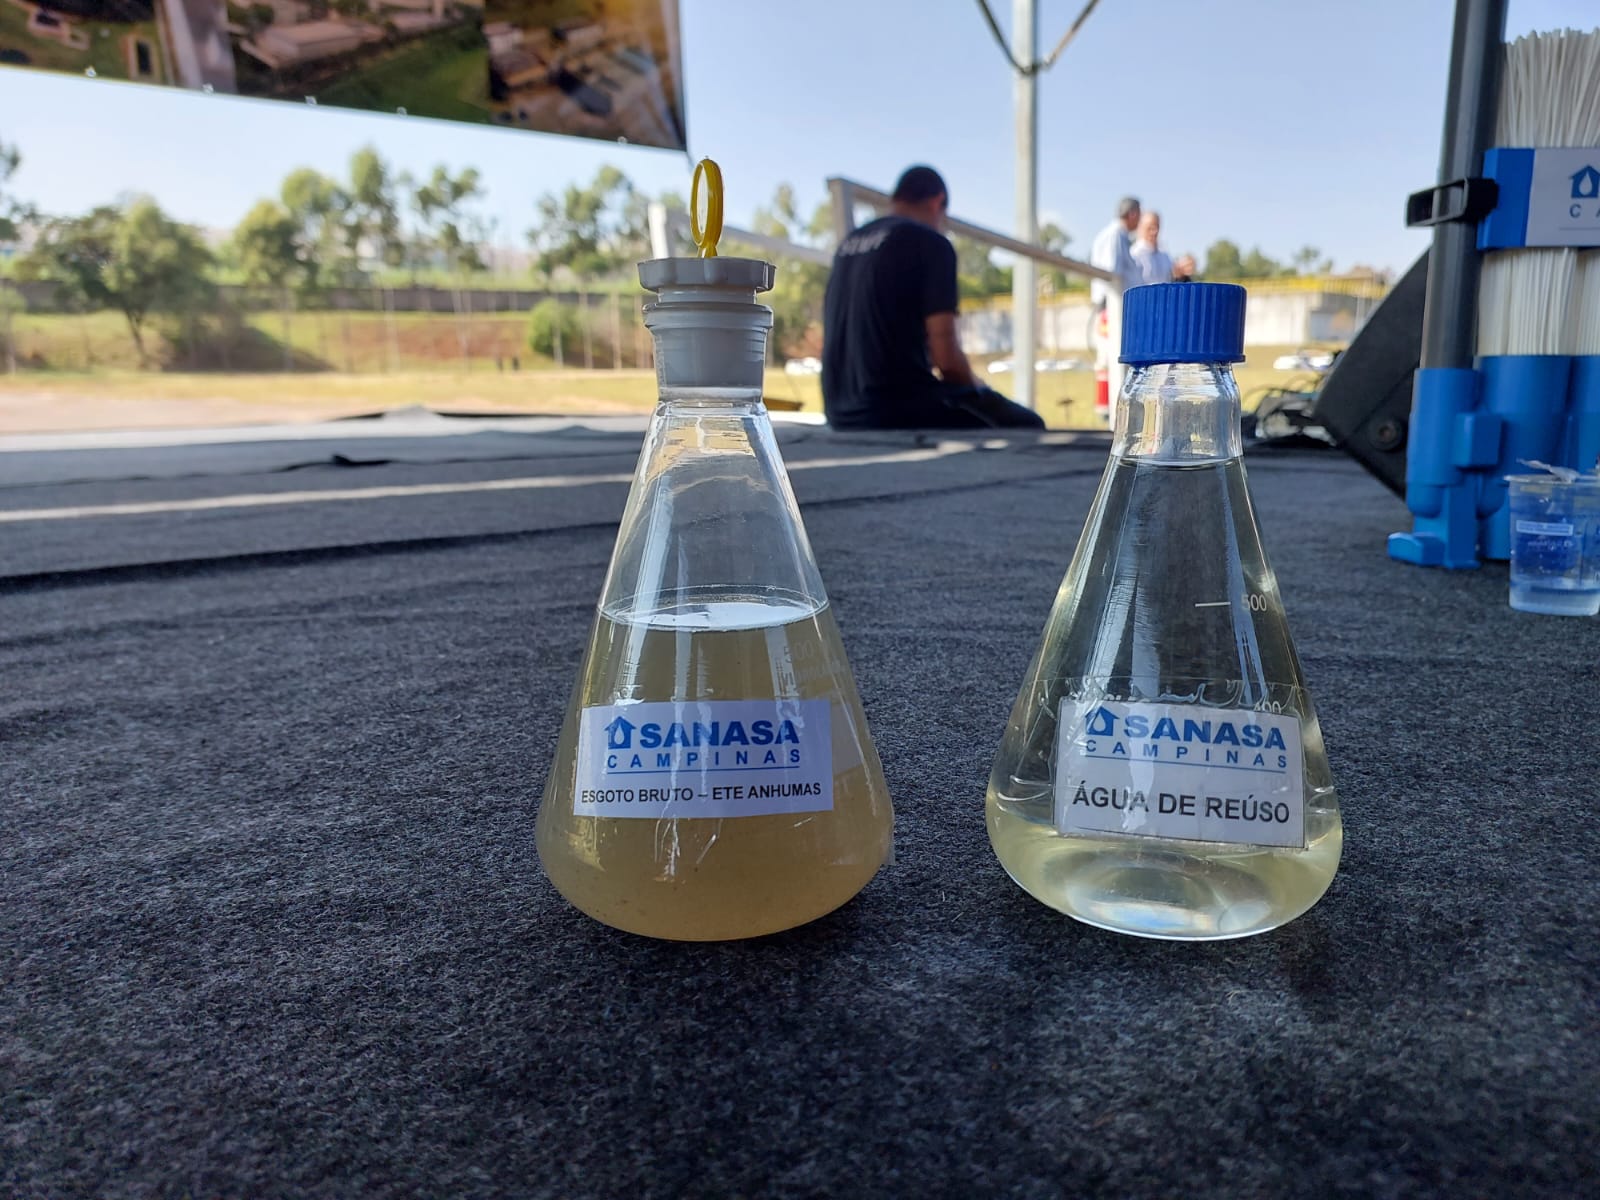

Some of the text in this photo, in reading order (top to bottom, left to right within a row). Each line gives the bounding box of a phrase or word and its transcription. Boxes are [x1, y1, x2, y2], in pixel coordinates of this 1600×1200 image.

[1241, 594, 1267, 611] 500
[639, 719, 800, 748] SANASA
[1124, 715, 1286, 750] SANASA
[607, 749, 800, 769] CAMPINAS
[1086, 739, 1287, 768] CAMPINAS
[581, 788, 634, 803] ESGOTO
[638, 787, 693, 802] BRUTO
[712, 786, 743, 800] ETE
[747, 782, 821, 798] ANHUMAS
[1072, 780, 1290, 824] ÁGUA DE REÚSO
